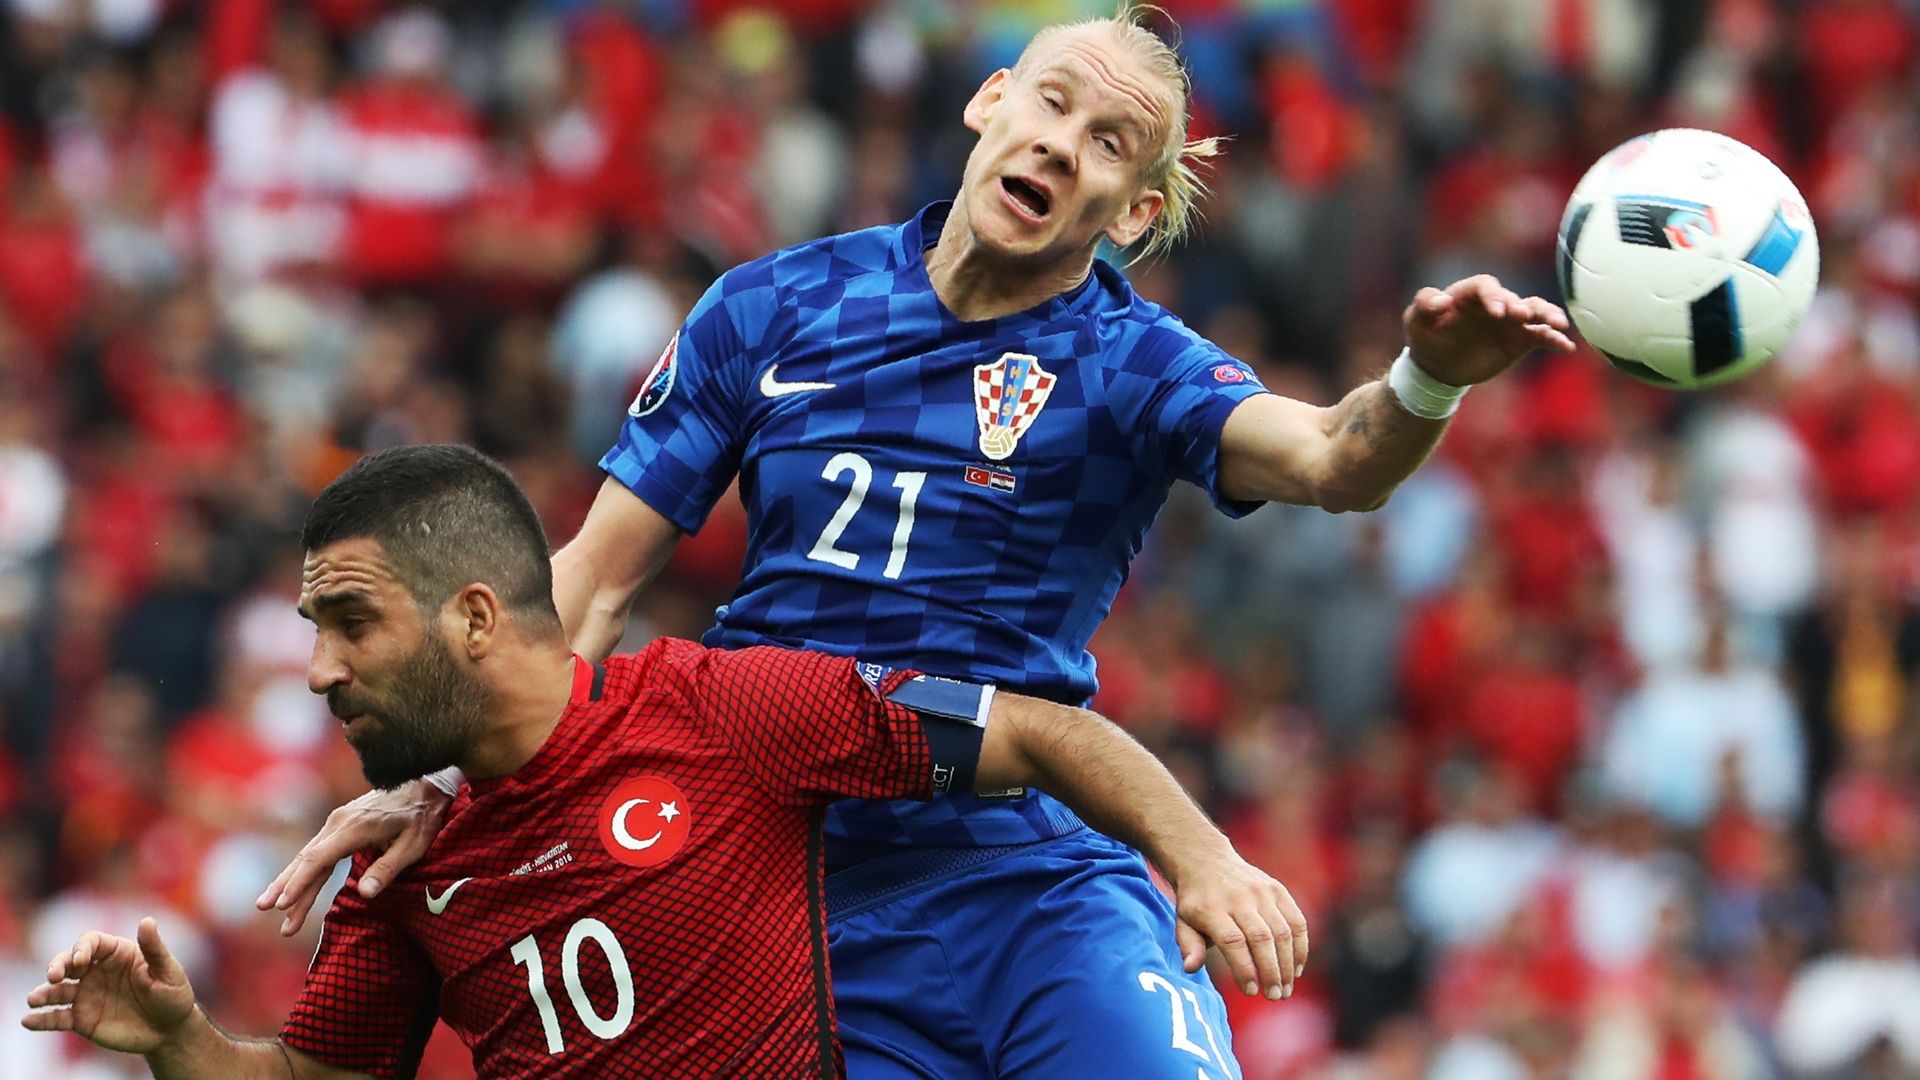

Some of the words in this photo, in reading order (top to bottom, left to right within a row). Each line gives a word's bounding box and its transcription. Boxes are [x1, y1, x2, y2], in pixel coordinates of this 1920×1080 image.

[1003, 365, 1022, 417] HNS
[807, 452, 928, 580] 21
[554, 853, 573, 869] 2016
[510, 917, 635, 1055] 10
[1137, 971, 1234, 1080] 21
